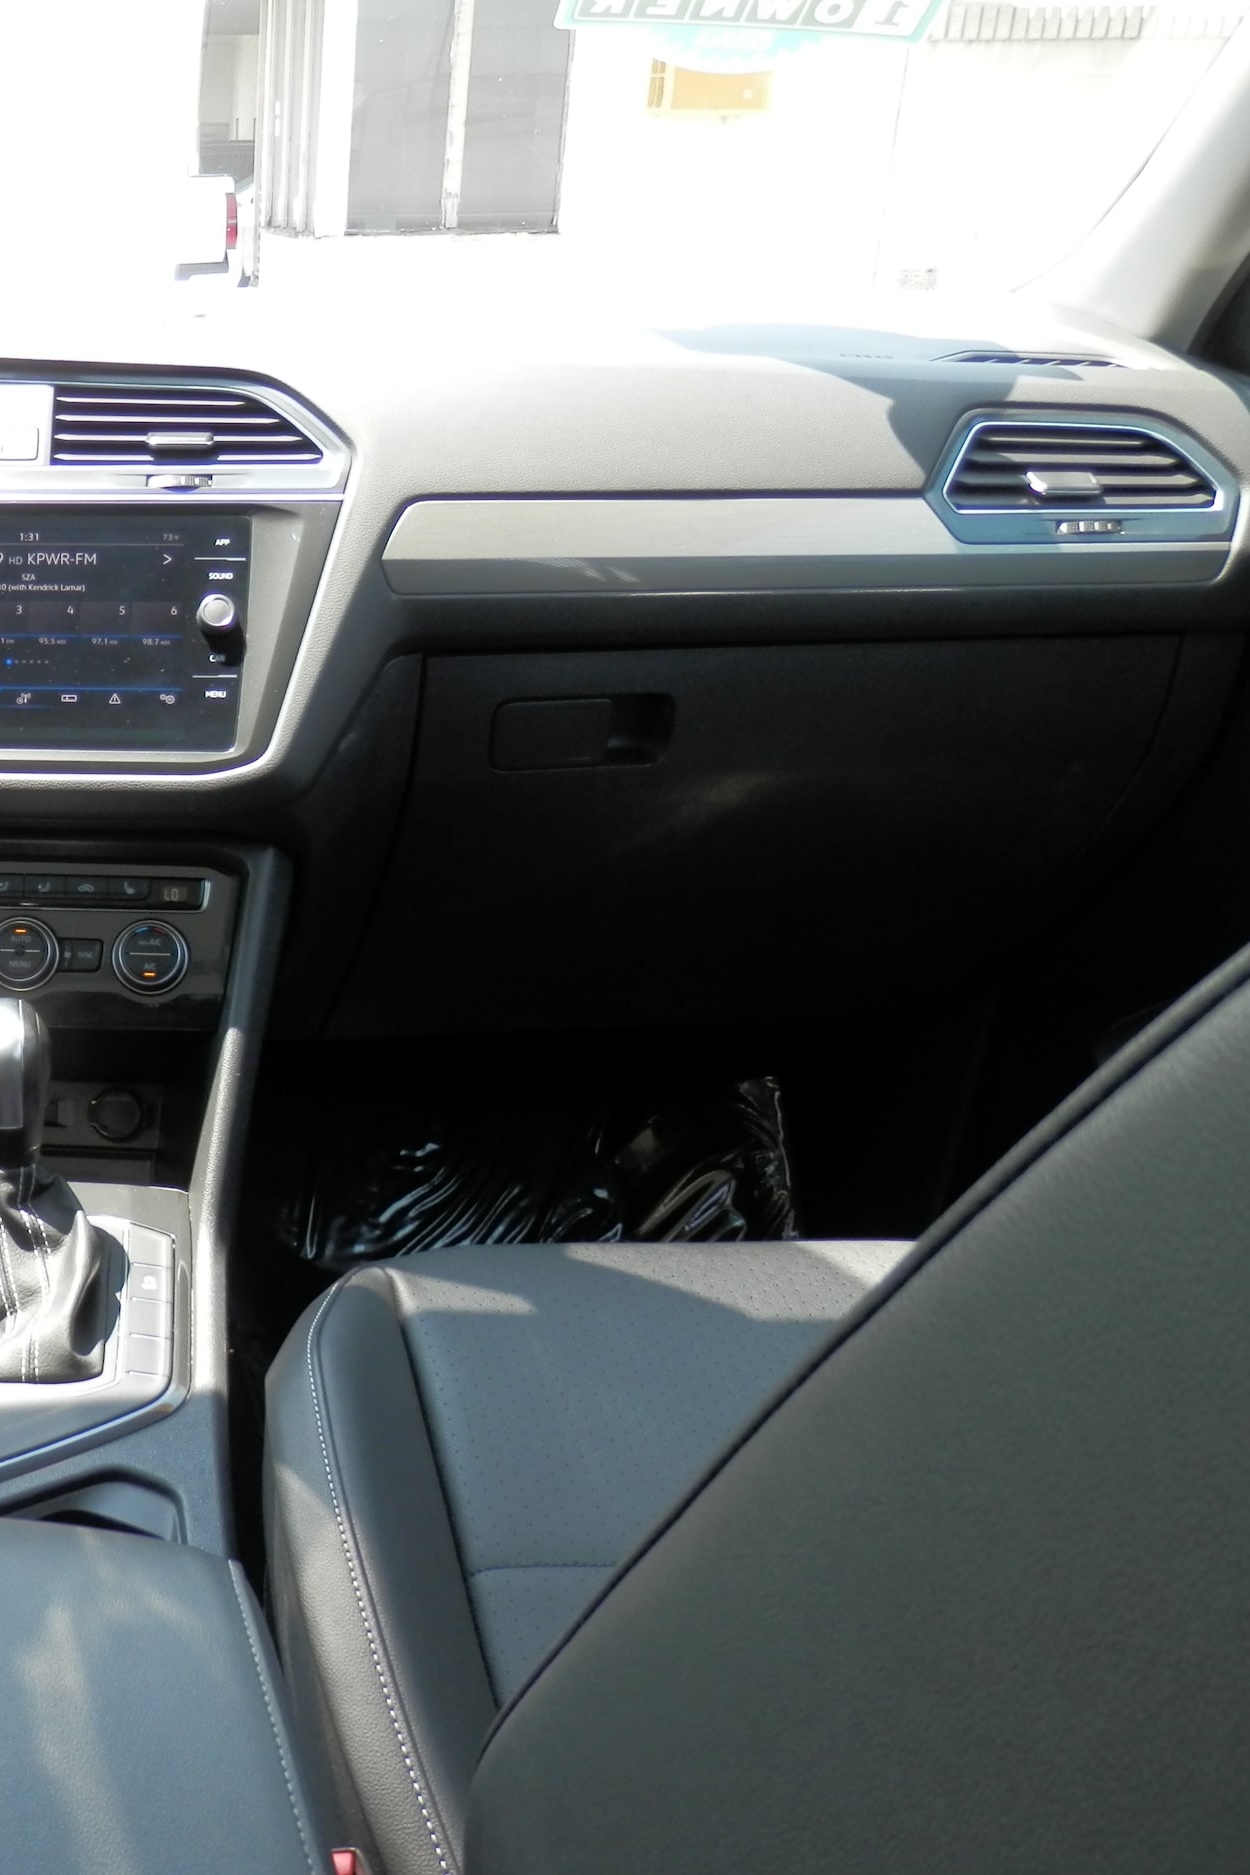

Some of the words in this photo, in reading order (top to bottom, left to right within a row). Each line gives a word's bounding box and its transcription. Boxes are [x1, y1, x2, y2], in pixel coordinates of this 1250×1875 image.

[19, 532, 40, 542] 1:31
[215, 538, 231, 546] APP
[8, 556, 23, 566] HD
[27, 552, 97, 566] KPWR-FM
[21, 573, 36, 582] SZA
[208, 572, 234, 580] SOUND
[8, 583, 27, 593] (with
[28, 583, 59, 591] Kendrick
[60, 583, 86, 593] Lamar)
[16, 604, 23, 615] 3
[67, 605, 74, 615] 4
[119, 605, 126, 616] 5
[170, 605, 178, 616] 6
[38, 637, 56, 645] 95.5
[91, 638, 108, 646] 97.1
[142, 638, 159, 646] 98.7
[205, 690, 227, 699] MENU
[10, 934, 32, 944] AUTO
[9, 960, 32, 968] MENU
